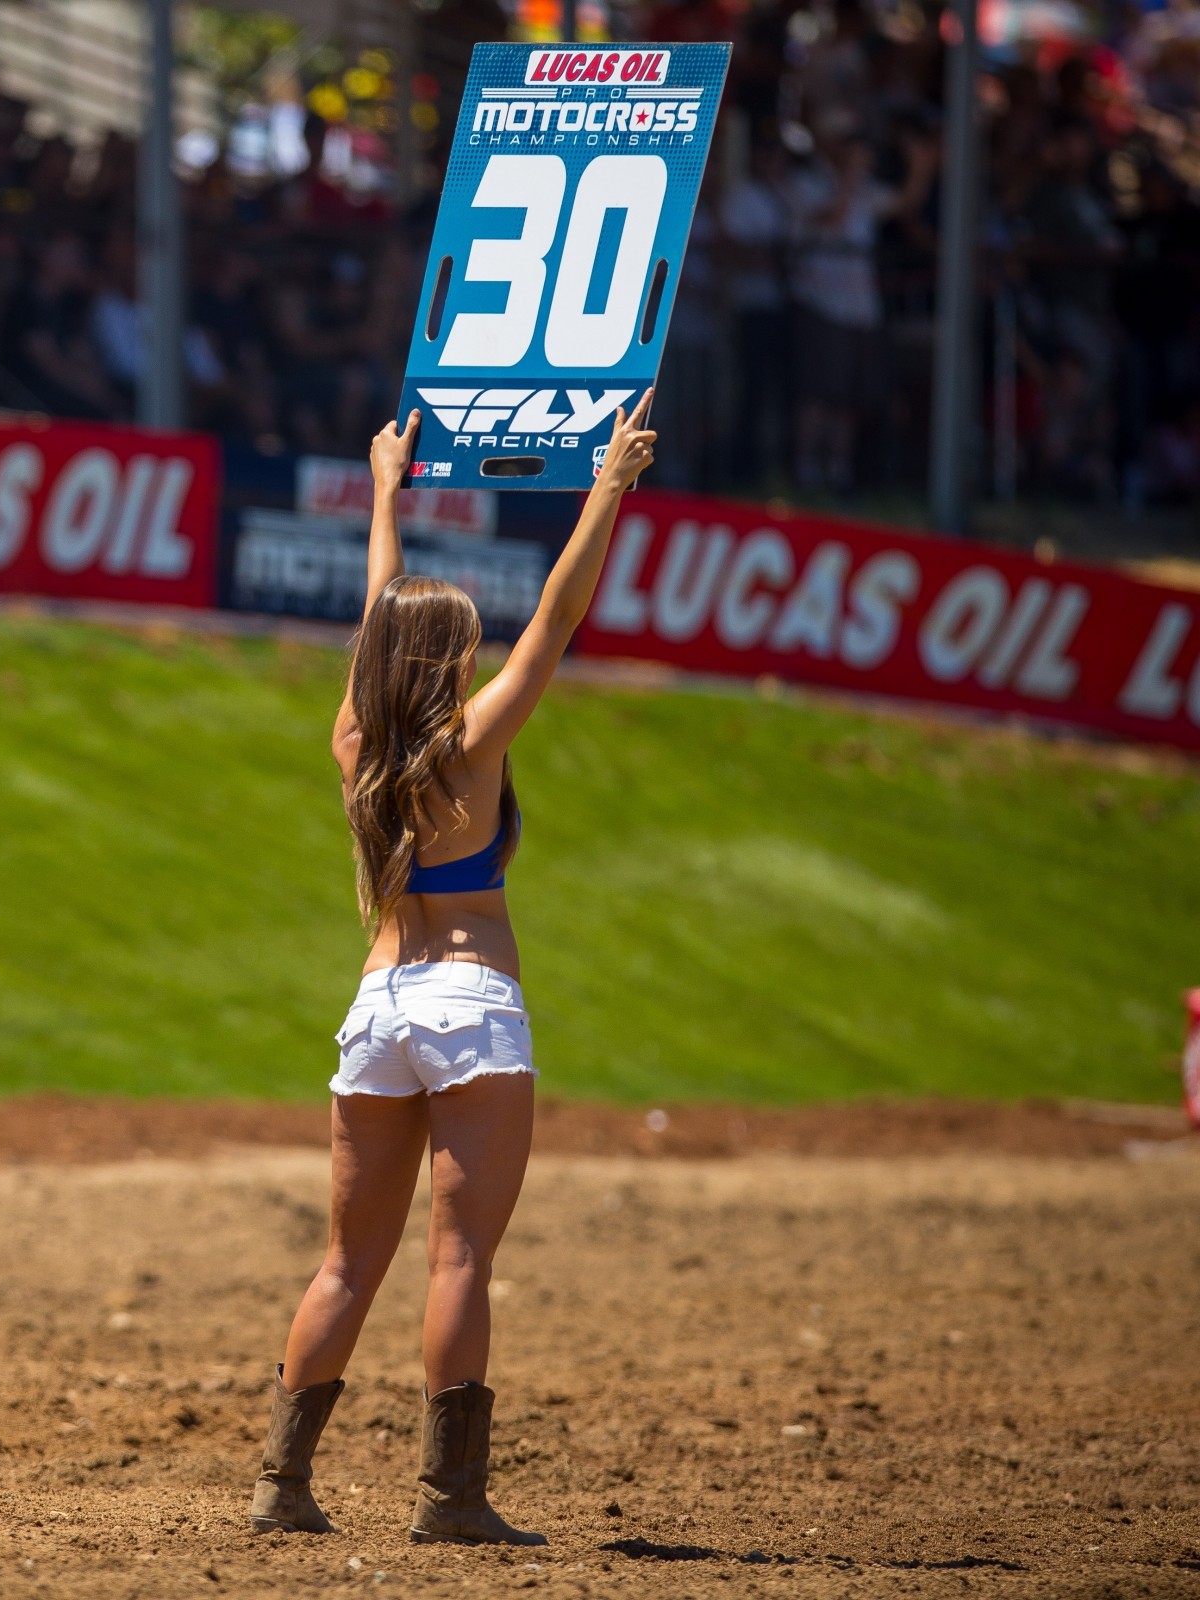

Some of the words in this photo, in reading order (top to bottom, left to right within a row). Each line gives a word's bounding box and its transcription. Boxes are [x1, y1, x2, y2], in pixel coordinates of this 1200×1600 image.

[530, 52, 621, 83] LUCAS
[621, 52, 662, 83] OIL
[560, 87, 623, 99] PRO
[472, 102, 701, 132] MOTOCROSS
[469, 134, 695, 146] CHAMPIONSHIP
[437, 154, 668, 368] 30
[416, 387, 637, 433] FLY
[453, 436, 579, 449] RACING
[433, 461, 453, 472] PRO
[40, 446, 194, 579] OIL
[591, 513, 921, 671] LUCAS
[919, 564, 1090, 701] OIL
[1116, 601, 1200, 729] L
